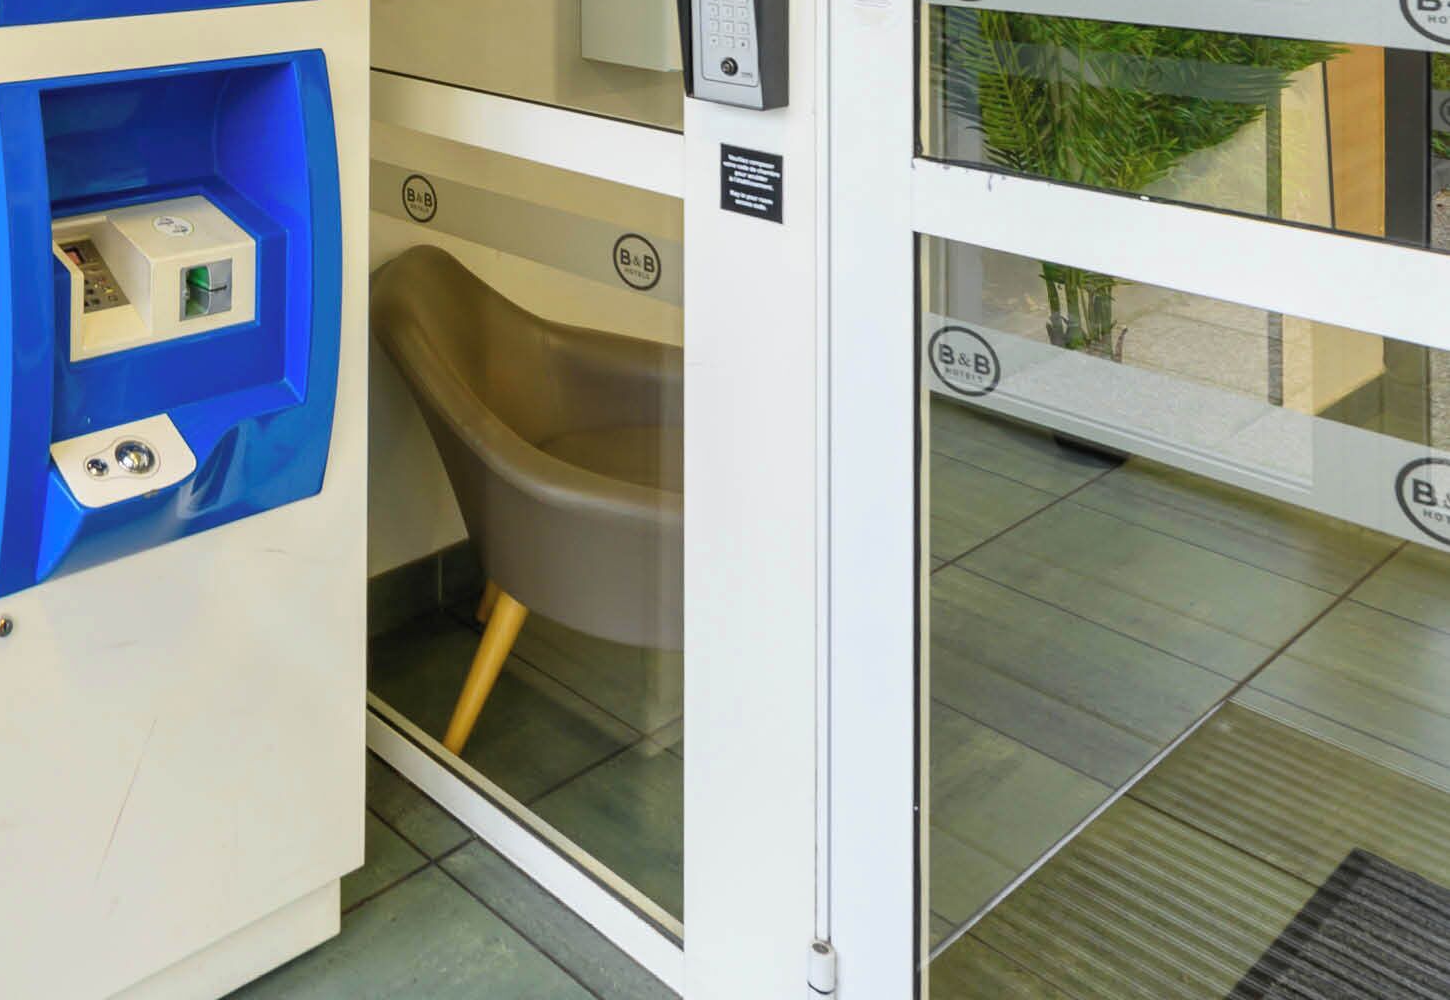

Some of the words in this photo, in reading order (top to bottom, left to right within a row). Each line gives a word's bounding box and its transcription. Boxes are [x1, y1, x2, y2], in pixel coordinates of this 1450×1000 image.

[406, 186, 432, 209] B&B
[620, 249, 656, 274] B&B
[938, 347, 992, 378] B&B
